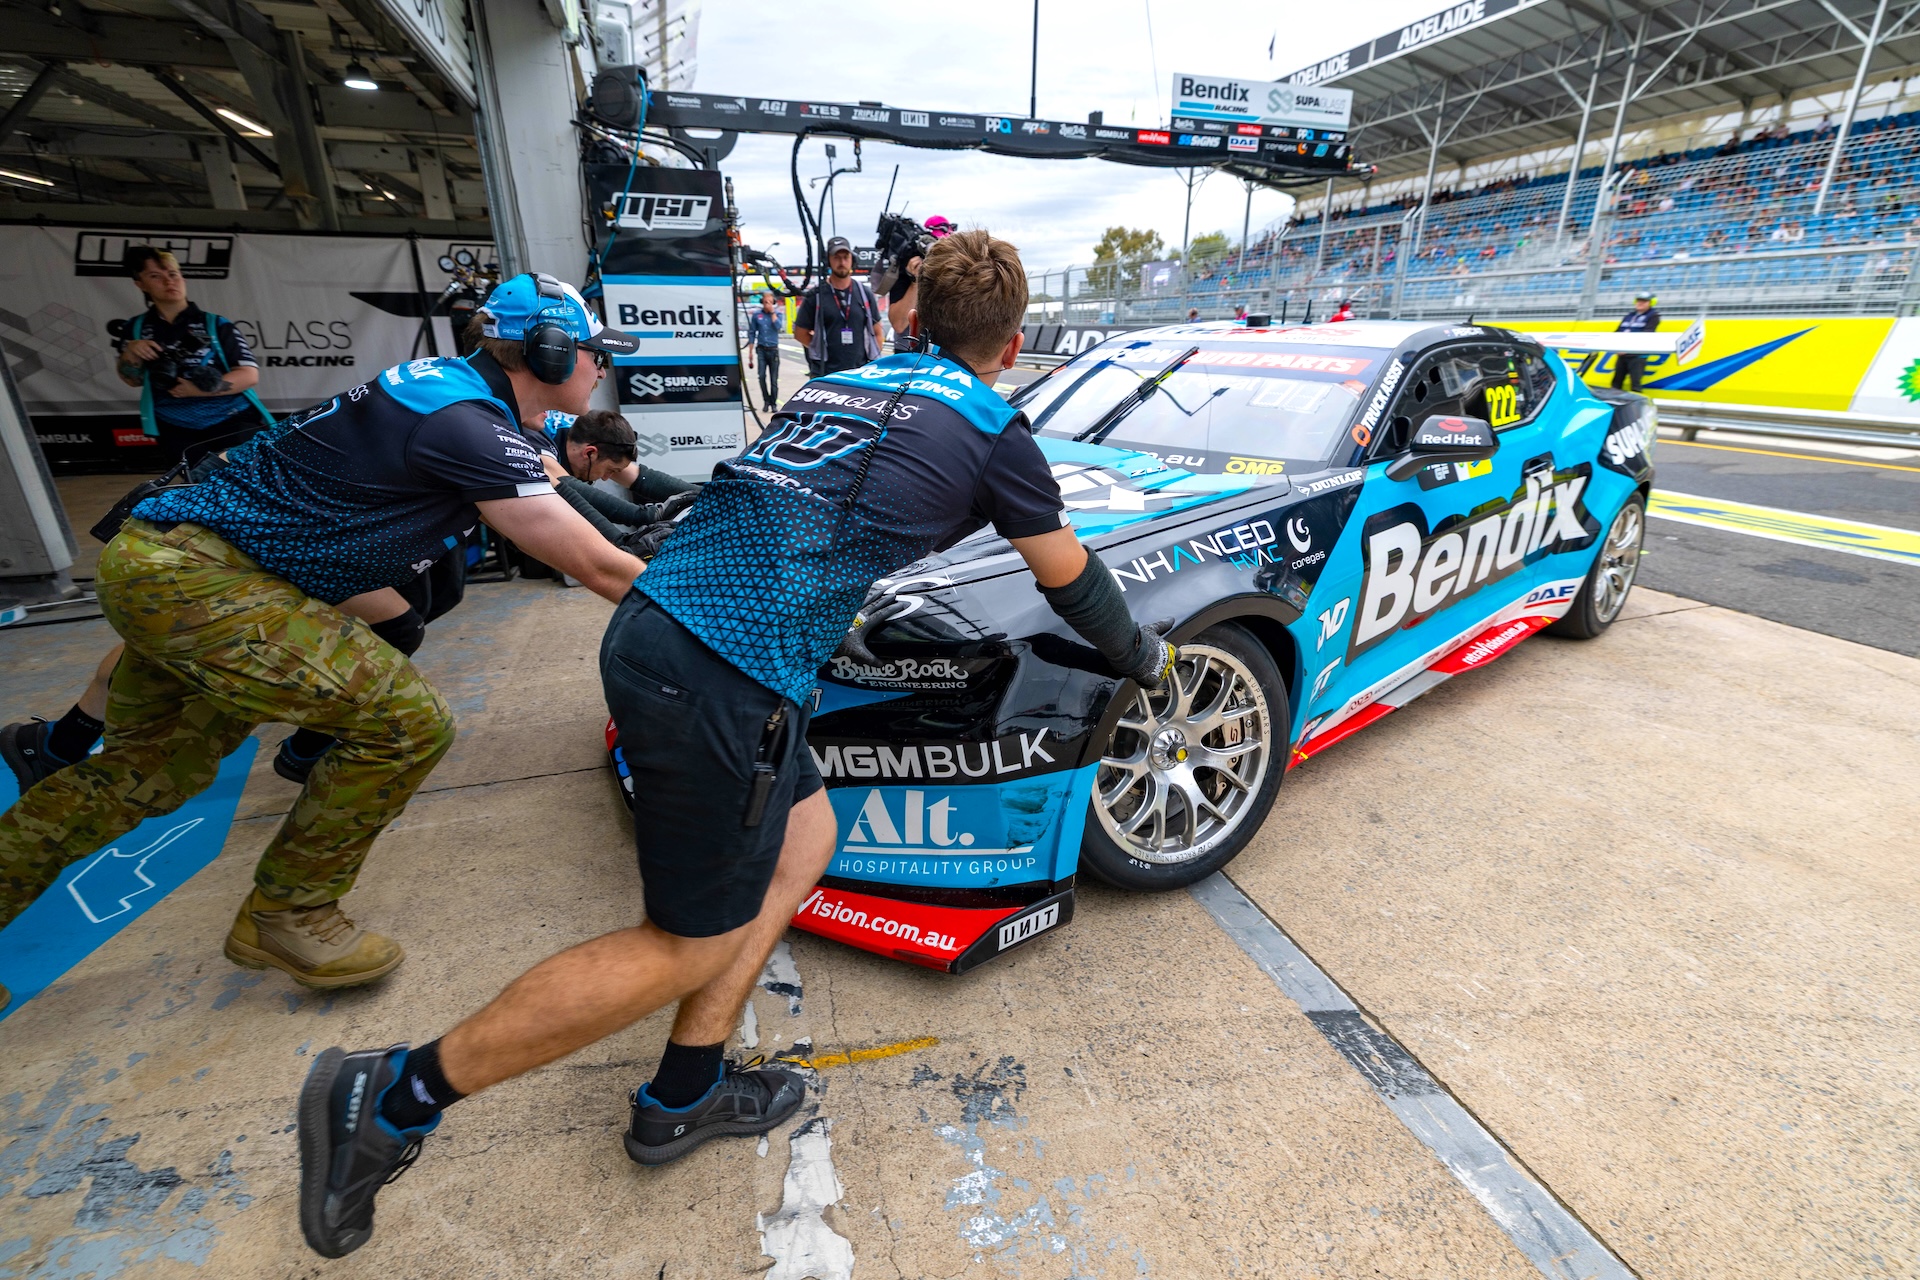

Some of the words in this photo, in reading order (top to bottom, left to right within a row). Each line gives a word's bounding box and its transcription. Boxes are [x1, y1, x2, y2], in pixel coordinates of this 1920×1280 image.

[1397, 1, 1486, 50] ADELAIDE
[1289, 53, 1350, 87] ADELAIDE
[1180, 77, 1250, 102] Bendix
[759, 100, 787, 112] AGI
[1214, 104, 1249, 114] RACING
[1296, 95, 1347, 109] SUPAGLASS
[903, 113, 927, 126] UNIT
[985, 117, 1012, 134] PPQ
[1095, 129, 1130, 140] MGMBULK
[1230, 137, 1257, 146] DAF
[1296, 128, 1314, 140] PPQ
[1265, 143, 1297, 153] coregas
[618, 303, 723, 326] Bendix
[1680, 327, 1702, 354] DAF
[267, 356, 355, 367] RACING
[1187, 351, 1254, 366] AUTO
[1252, 354, 1356, 374] PARTS
[664, 376, 728, 387] SUPAGLASS
[1485, 385, 1521, 427] 222
[670, 434, 738, 446] SUPAGLASS
[1421, 434, 1452, 444] Red
[1453, 434, 1481, 445] Hat
[1131, 465, 1168, 478] ZL1
[1225, 460, 1284, 476] OMP
[1311, 470, 1362, 493] DUNLOP
[1109, 519, 1277, 592] NHANCED
[1229, 543, 1284, 572] HVAC
[1292, 549, 1326, 570] coregas
[1355, 470, 1589, 647] Bendix
[1526, 585, 1576, 604] DAF
[830, 656, 897, 684] Bruce
[896, 658, 969, 680] Rock
[869, 680, 968, 689] ENGINEERING
[1247, 676, 1270, 735] SUPERCARS
[809, 727, 1056, 779] MGMBULK
[847, 789, 976, 847] Alt.
[1133, 848, 1173, 862] INDUSTRIES
[1175, 849, 1197, 862] RACER
[839, 859, 963, 875] HOSPITALITY
[968, 857, 1036, 875] GROUP
